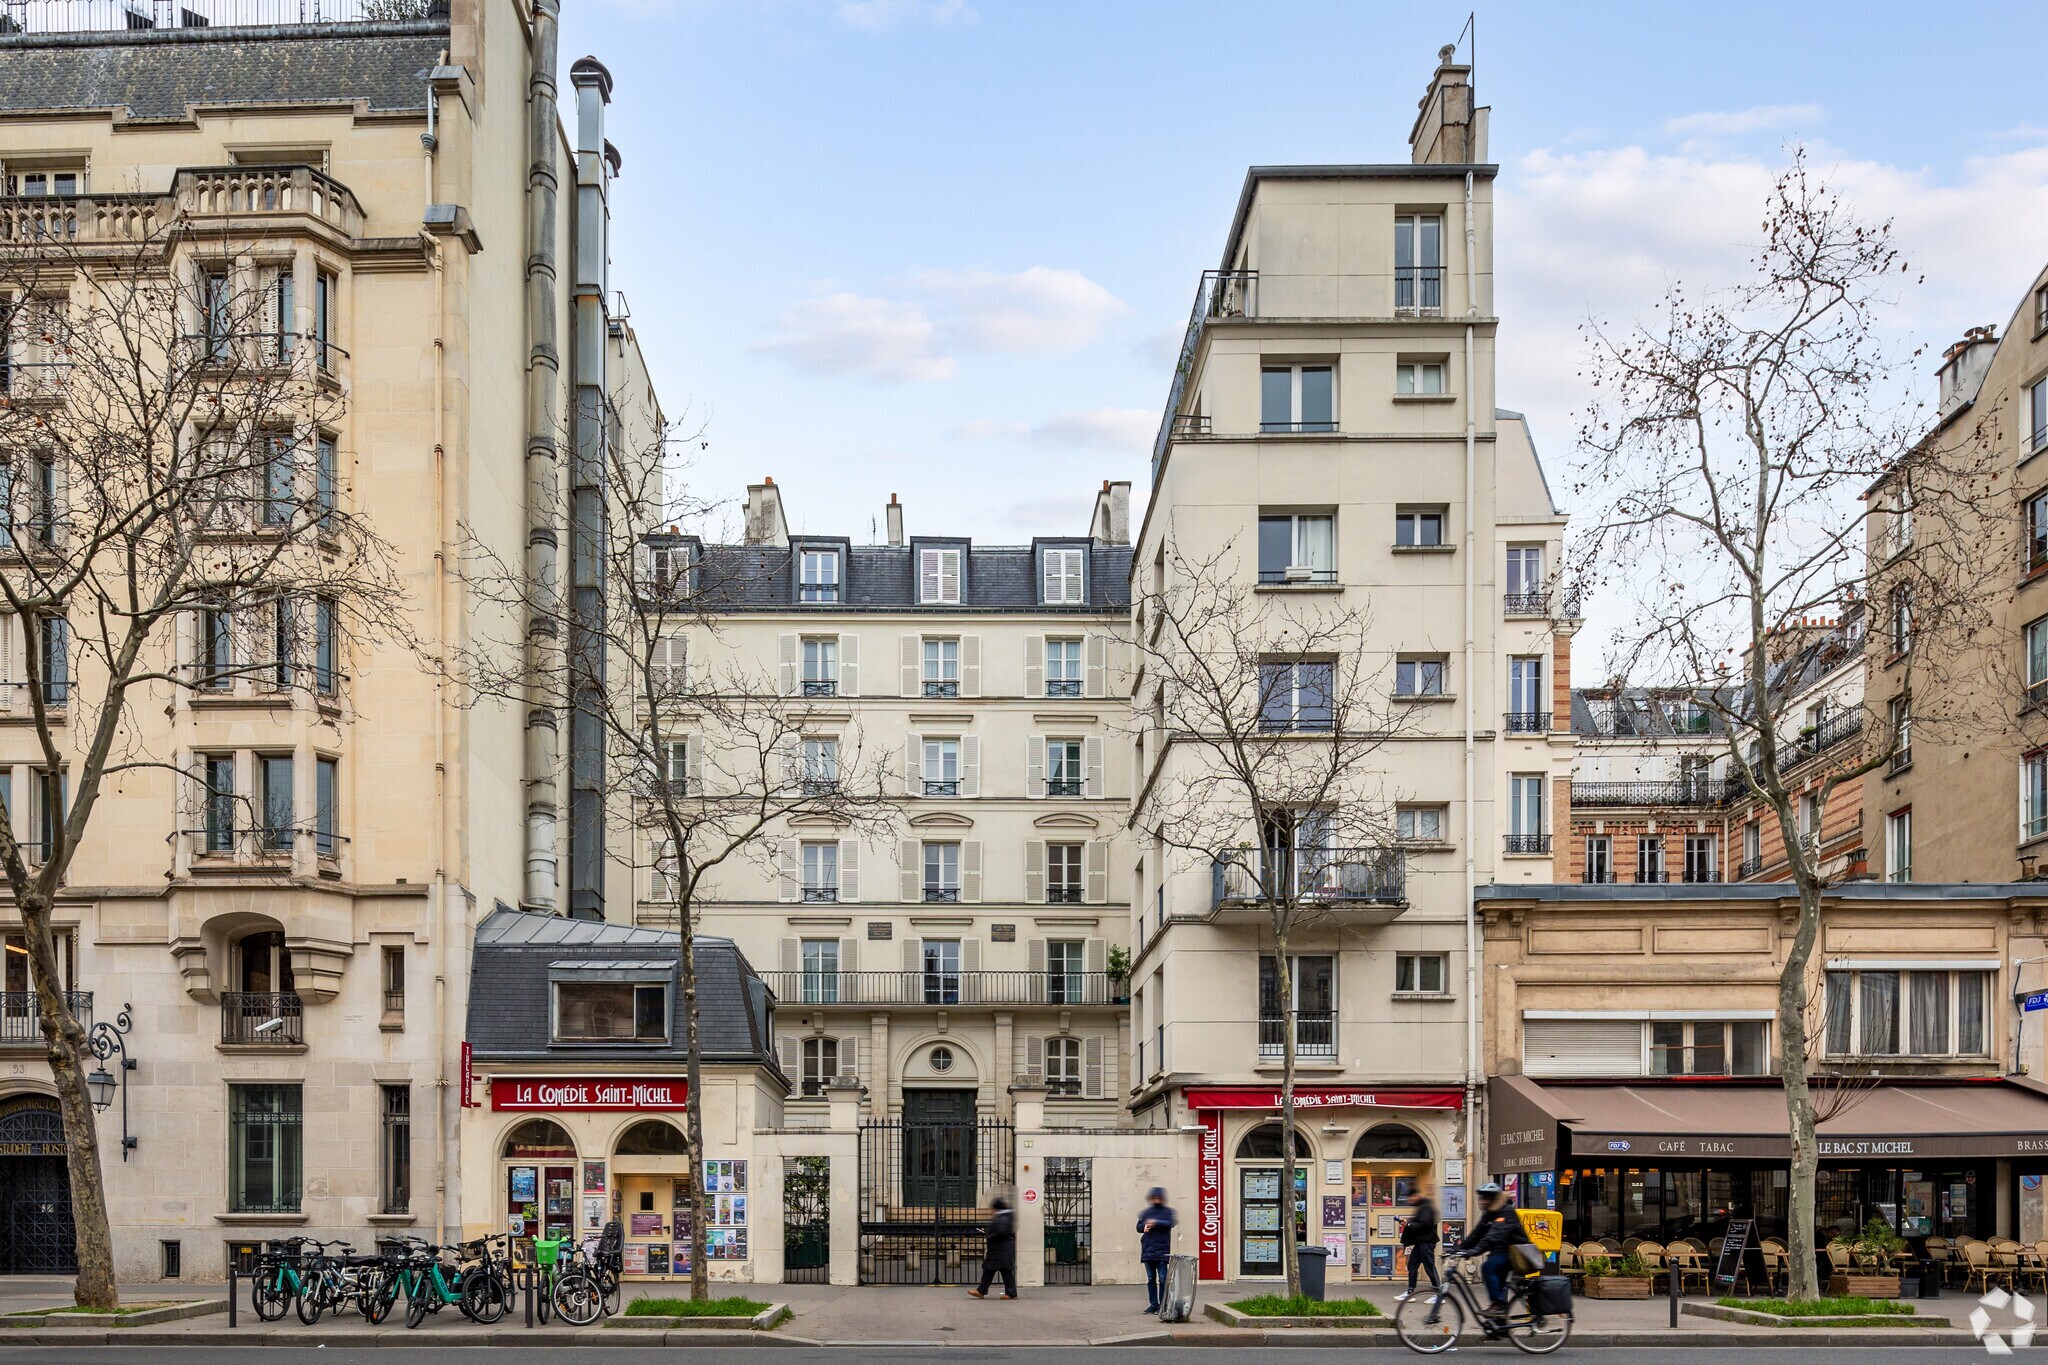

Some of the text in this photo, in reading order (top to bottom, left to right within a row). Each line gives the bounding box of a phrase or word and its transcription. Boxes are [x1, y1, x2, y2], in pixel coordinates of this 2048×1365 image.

[2028, 996, 2041, 1005] FDJ
[13, 1064, 25, 1074] 93
[517, 1084, 532, 1103] LA
[1292, 1094, 1322, 1106] OMÉDIE
[1501, 1129, 1545, 1145] LE BAC ST MICHEL
[1659, 1141, 1685, 1151] CAFÉ
[1700, 1142, 1734, 1152] TABAC
[1819, 1142, 1914, 1153] LE BAC ST MICHEL
[1504, 1156, 1542, 1167] TABAC BRASSERIE
[1202, 1240, 1217, 1253] LA
